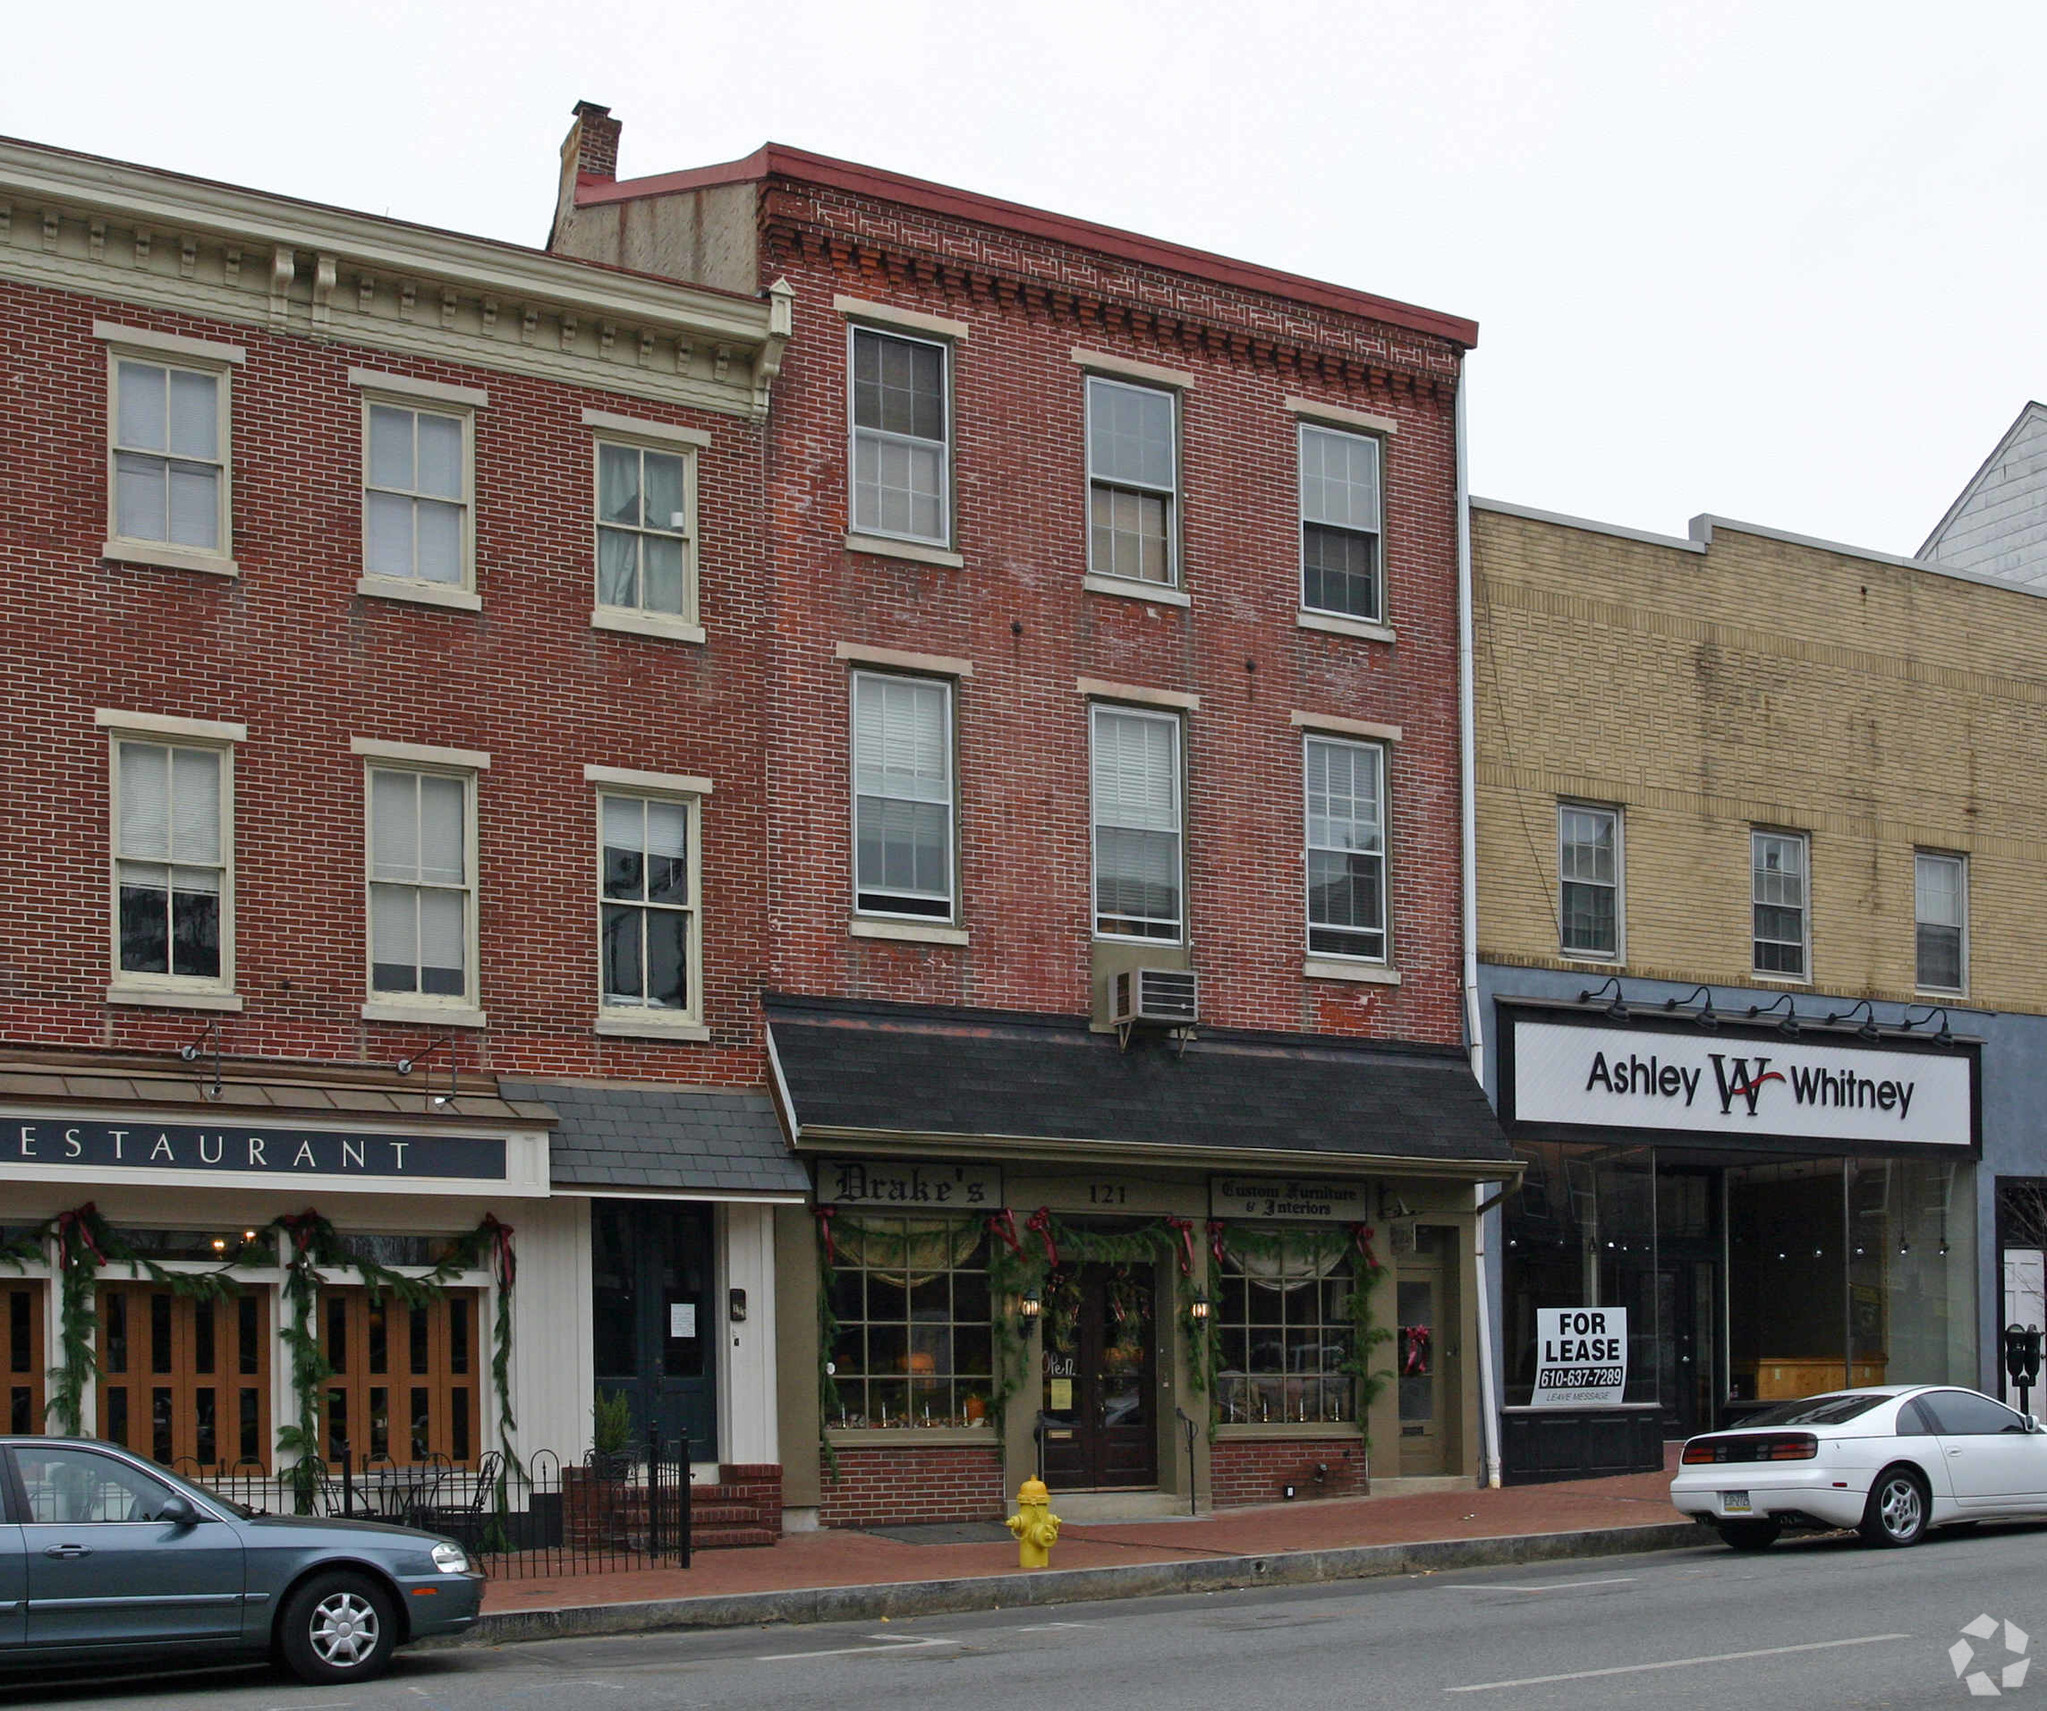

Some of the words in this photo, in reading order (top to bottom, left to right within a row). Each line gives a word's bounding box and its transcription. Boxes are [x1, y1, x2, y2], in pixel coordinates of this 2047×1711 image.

[1586, 1051, 1701, 1107] Ashley
[1790, 1065, 1915, 1120] Whitney
[832, 1162, 985, 1204] Drake's
[1222, 1181, 1279, 1198] Custom
[1283, 1181, 1357, 1201] Furniture
[1089, 1184, 1126, 1204] 121
[1262, 1198, 1331, 1216] Interiors
[1559, 1312, 1606, 1335] FOR
[1545, 1338, 1620, 1362] LEASE
[1540, 1368, 1622, 1387] 610-637-7289
[1546, 1392, 1572, 1401] LEAVE
[1573, 1391, 1611, 1400] MESSAGE
